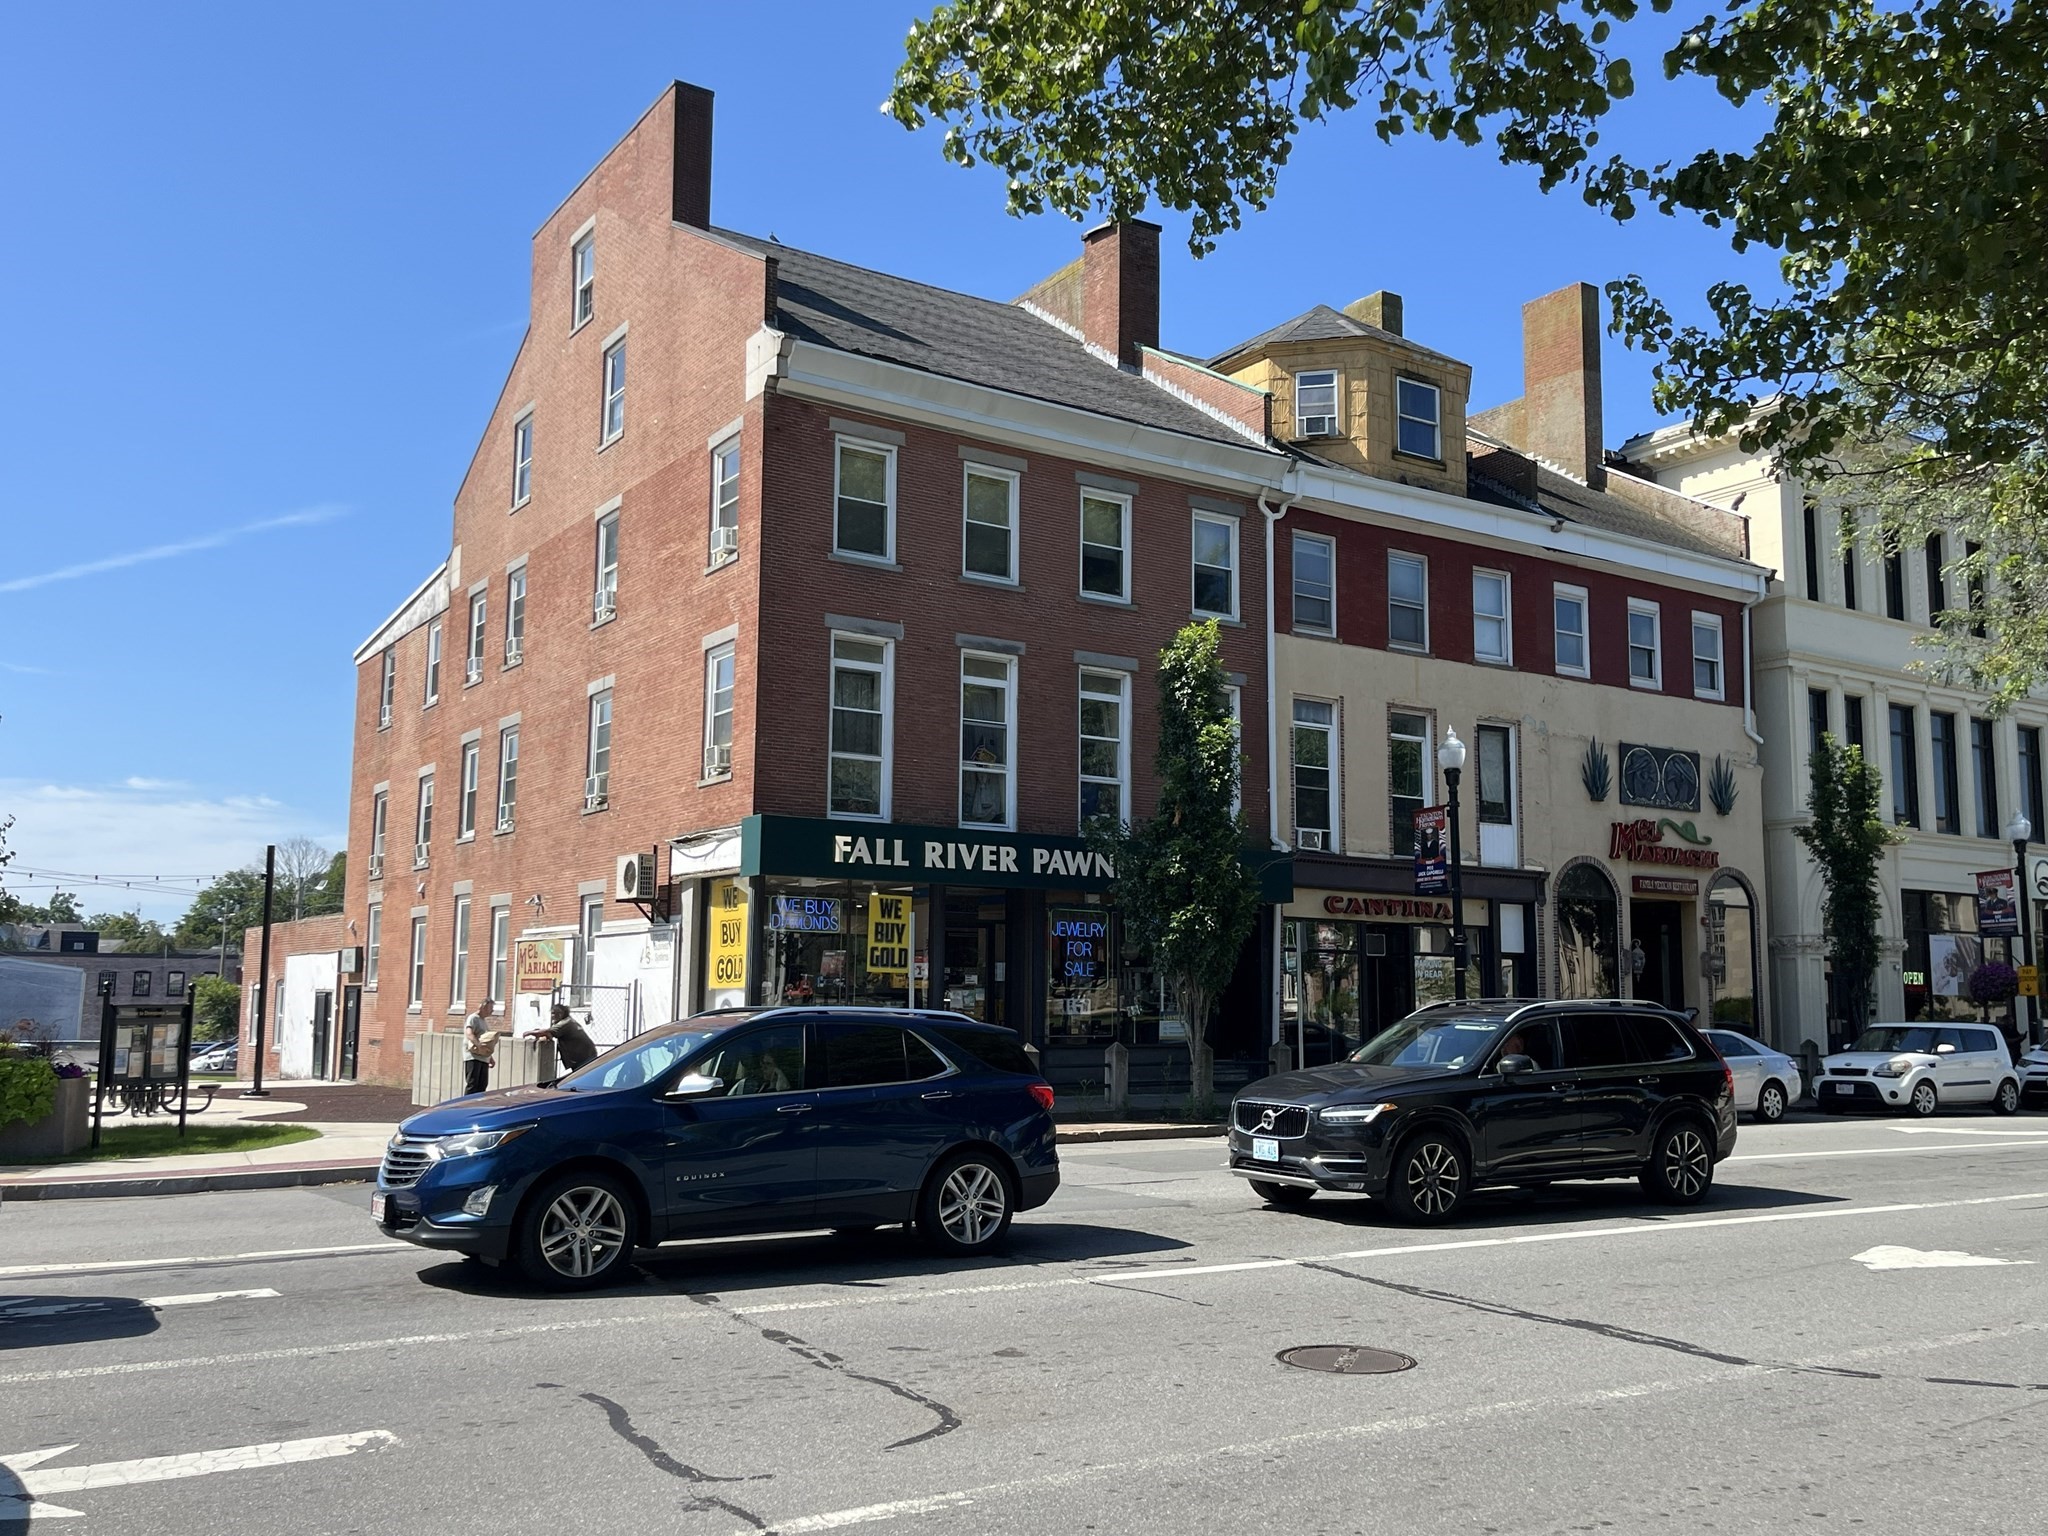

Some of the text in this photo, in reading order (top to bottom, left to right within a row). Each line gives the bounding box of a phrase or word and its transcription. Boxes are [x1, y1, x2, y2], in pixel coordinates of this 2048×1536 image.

[834, 835, 1120, 879] FALL RIVER PAWN
[723, 886, 738, 911] WE
[776, 898, 835, 915] WE BUY
[879, 898, 902, 920] WE
[1323, 895, 1453, 919] CANTINA
[771, 913, 839, 931] DIAMONDS
[874, 922, 906, 944] BUY
[1051, 921, 1107, 938] JEWELRY
[721, 920, 742, 947] BUY
[870, 947, 908, 969] GOLD
[1066, 941, 1092, 957] FOR
[517, 948, 562, 975] MARIACHI
[717, 955, 743, 983] GOLD
[1064, 961, 1095, 977] SALE
[1415, 970, 1444, 979] IN REAR
[1903, 971, 1924, 985] OPEN
[676, 1172, 725, 1182] EQUINOX
